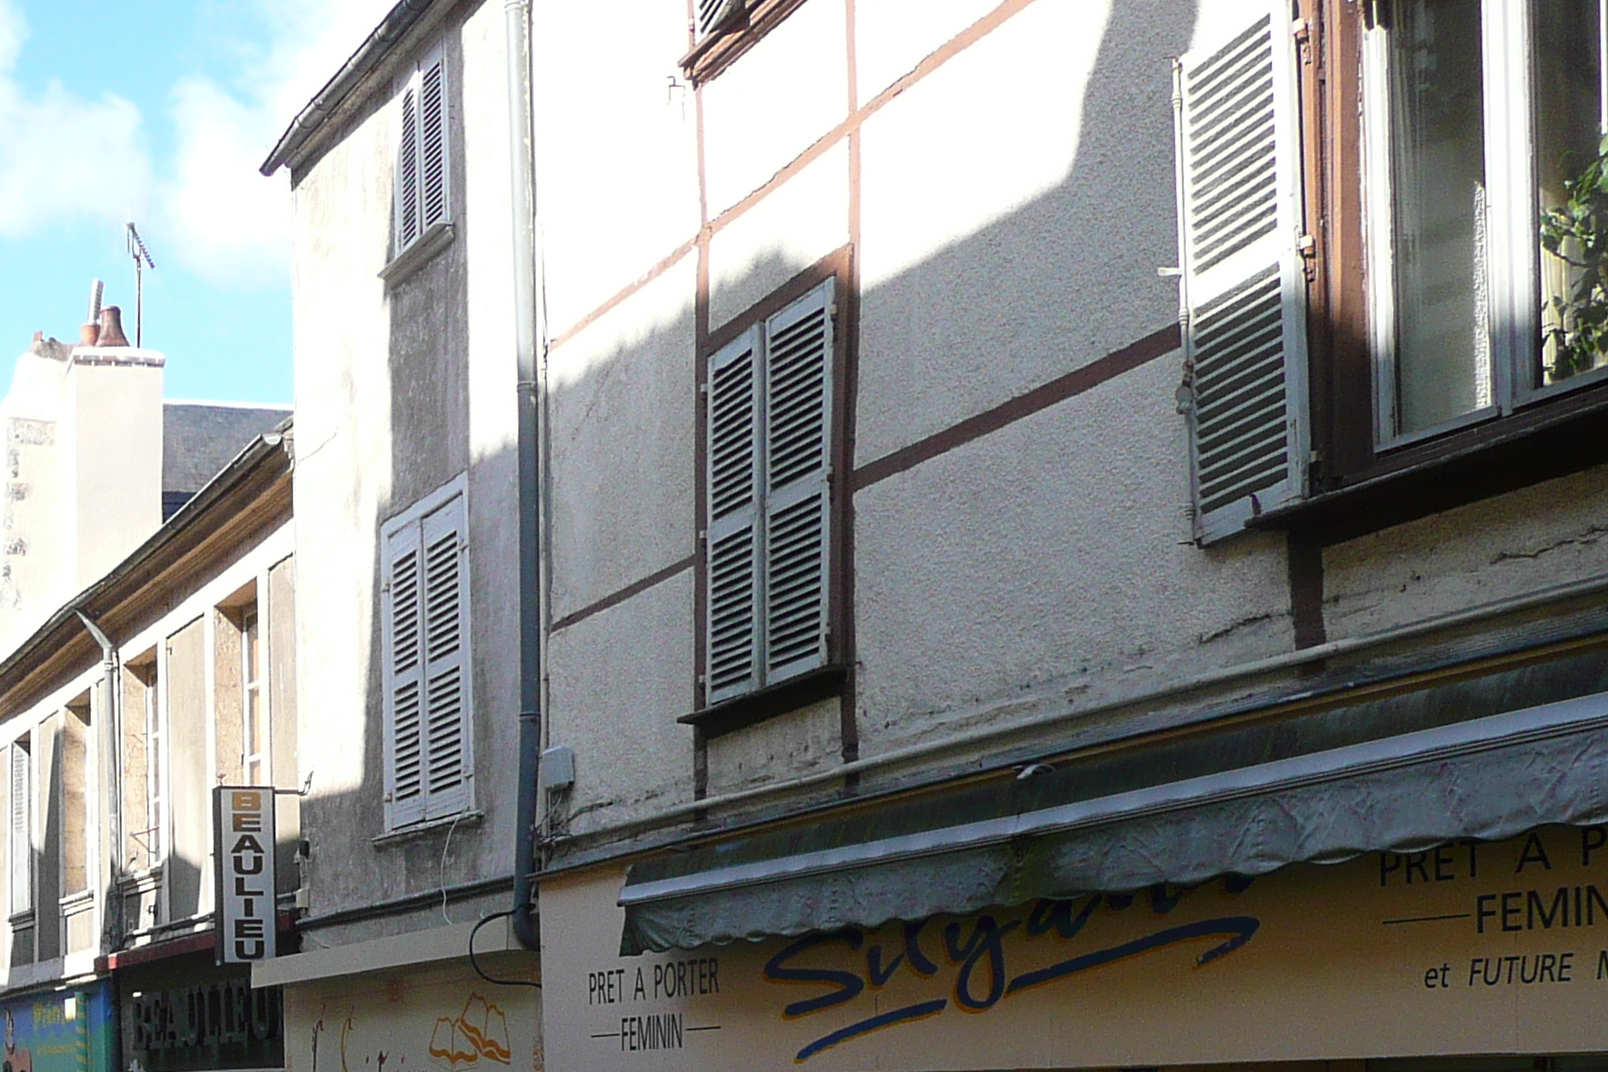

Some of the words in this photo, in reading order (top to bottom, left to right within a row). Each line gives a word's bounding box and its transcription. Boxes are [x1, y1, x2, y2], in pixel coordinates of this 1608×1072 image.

[231, 790, 265, 961] BEAULIEU
[1379, 842, 1477, 887] PRET
[1515, 832, 1552, 874] A
[588, 969, 624, 1006] PRET
[633, 966, 646, 1001] A
[654, 957, 720, 1001] PORTER
[1424, 961, 1451, 989] et
[1468, 952, 1574, 987] FUTURE
[620, 1013, 684, 1052] FEMININ
